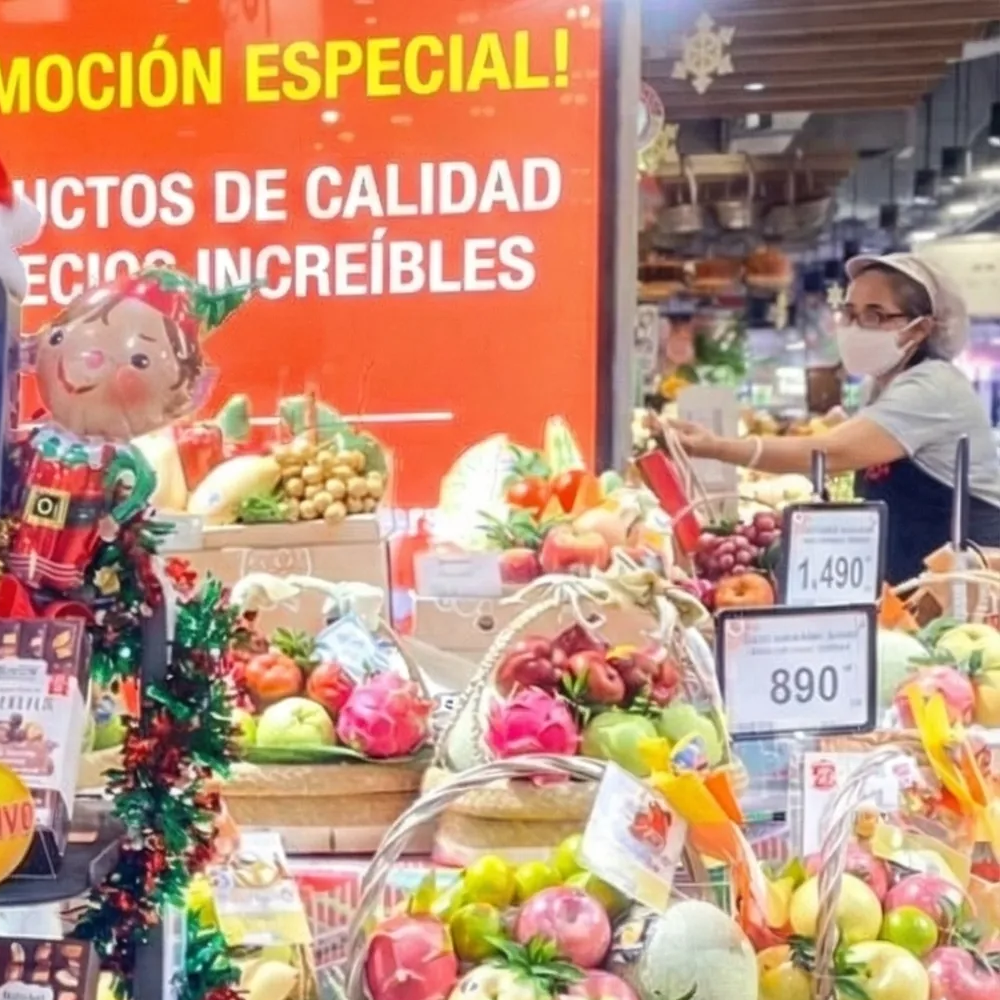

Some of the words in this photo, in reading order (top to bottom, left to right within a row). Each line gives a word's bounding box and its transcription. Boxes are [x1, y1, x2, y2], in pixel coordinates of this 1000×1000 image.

[246, 28, 569, 102] ESPECIAL!
[214, 169, 287, 223] DE
[305, 157, 563, 220] CALIDAD
[197, 227, 537, 300] INCREÍBLES
[770, 664, 838, 704] 890
